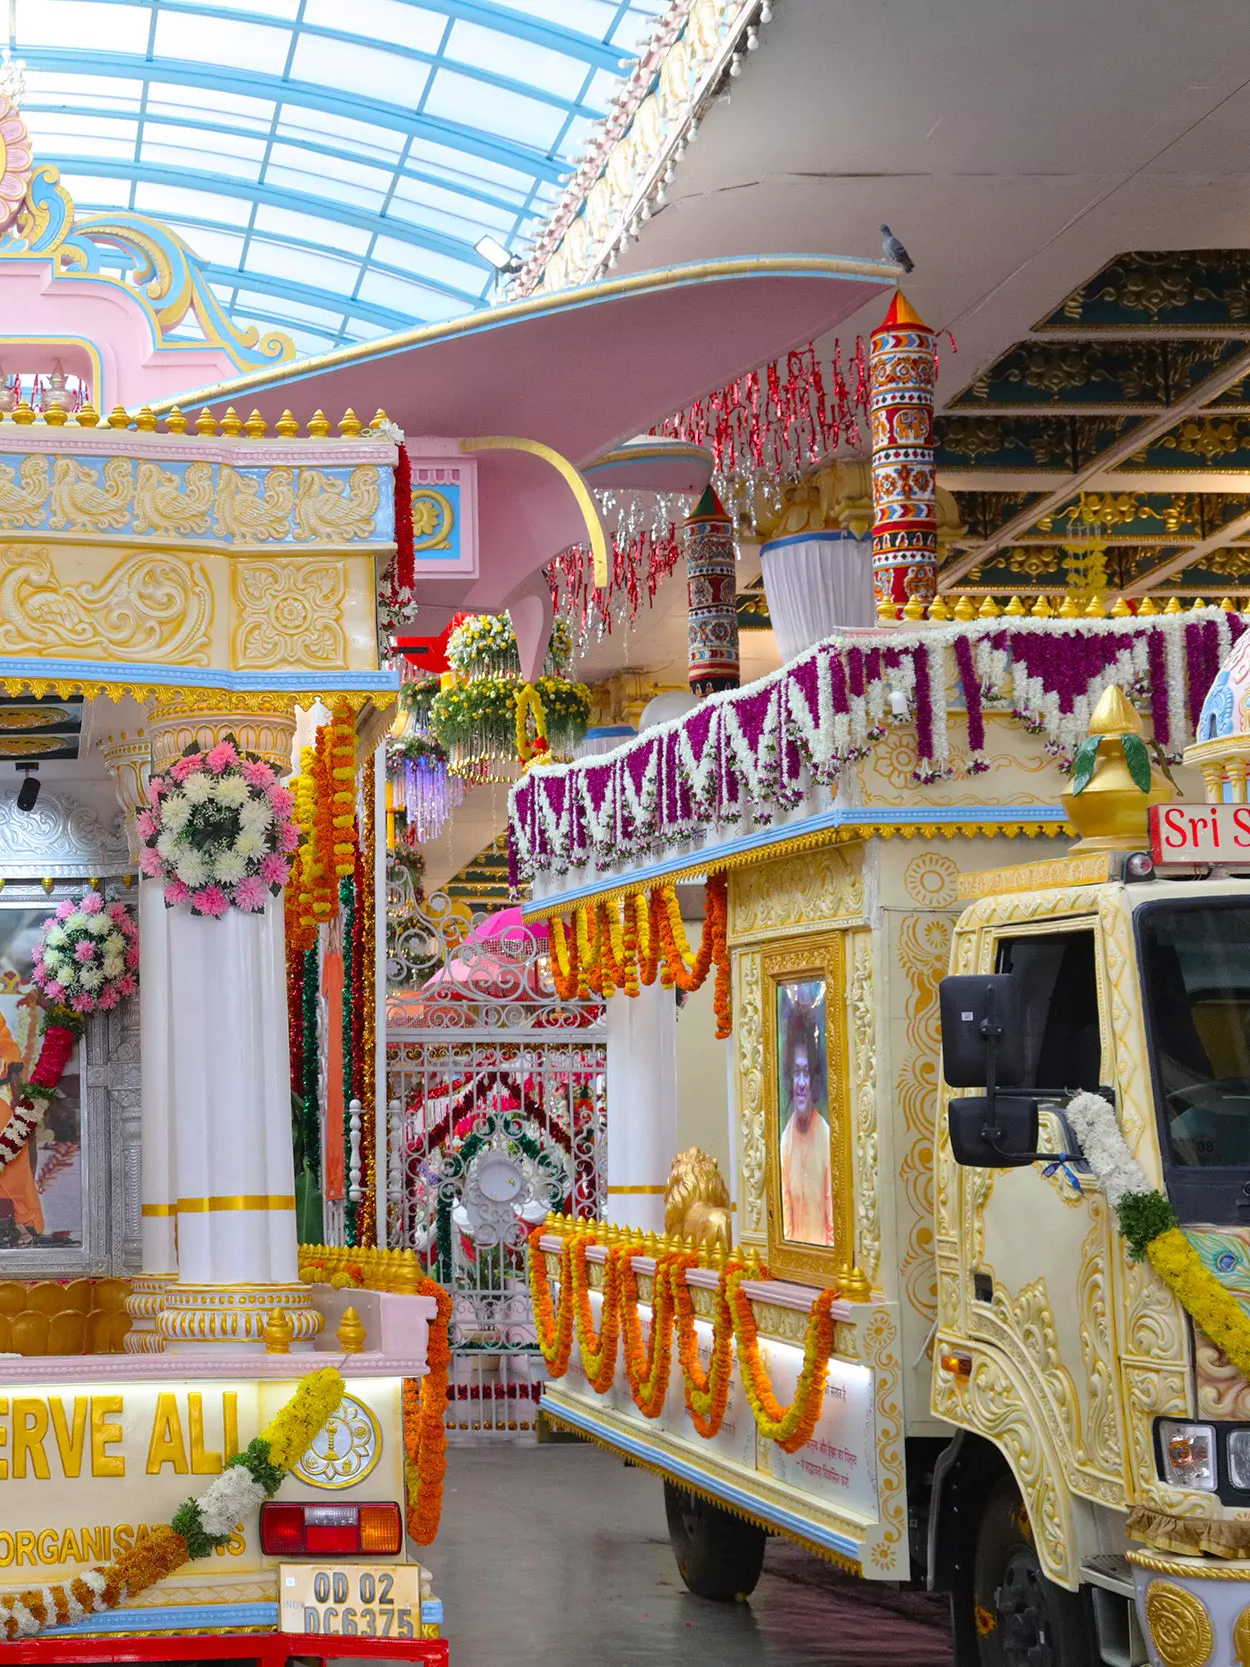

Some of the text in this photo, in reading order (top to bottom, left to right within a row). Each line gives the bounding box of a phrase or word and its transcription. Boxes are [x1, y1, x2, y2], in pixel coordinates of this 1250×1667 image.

[1164, 807, 1220, 848] Sri
[359, 1573, 395, 1605] 02
[303, 1607, 414, 1638] DC6375
